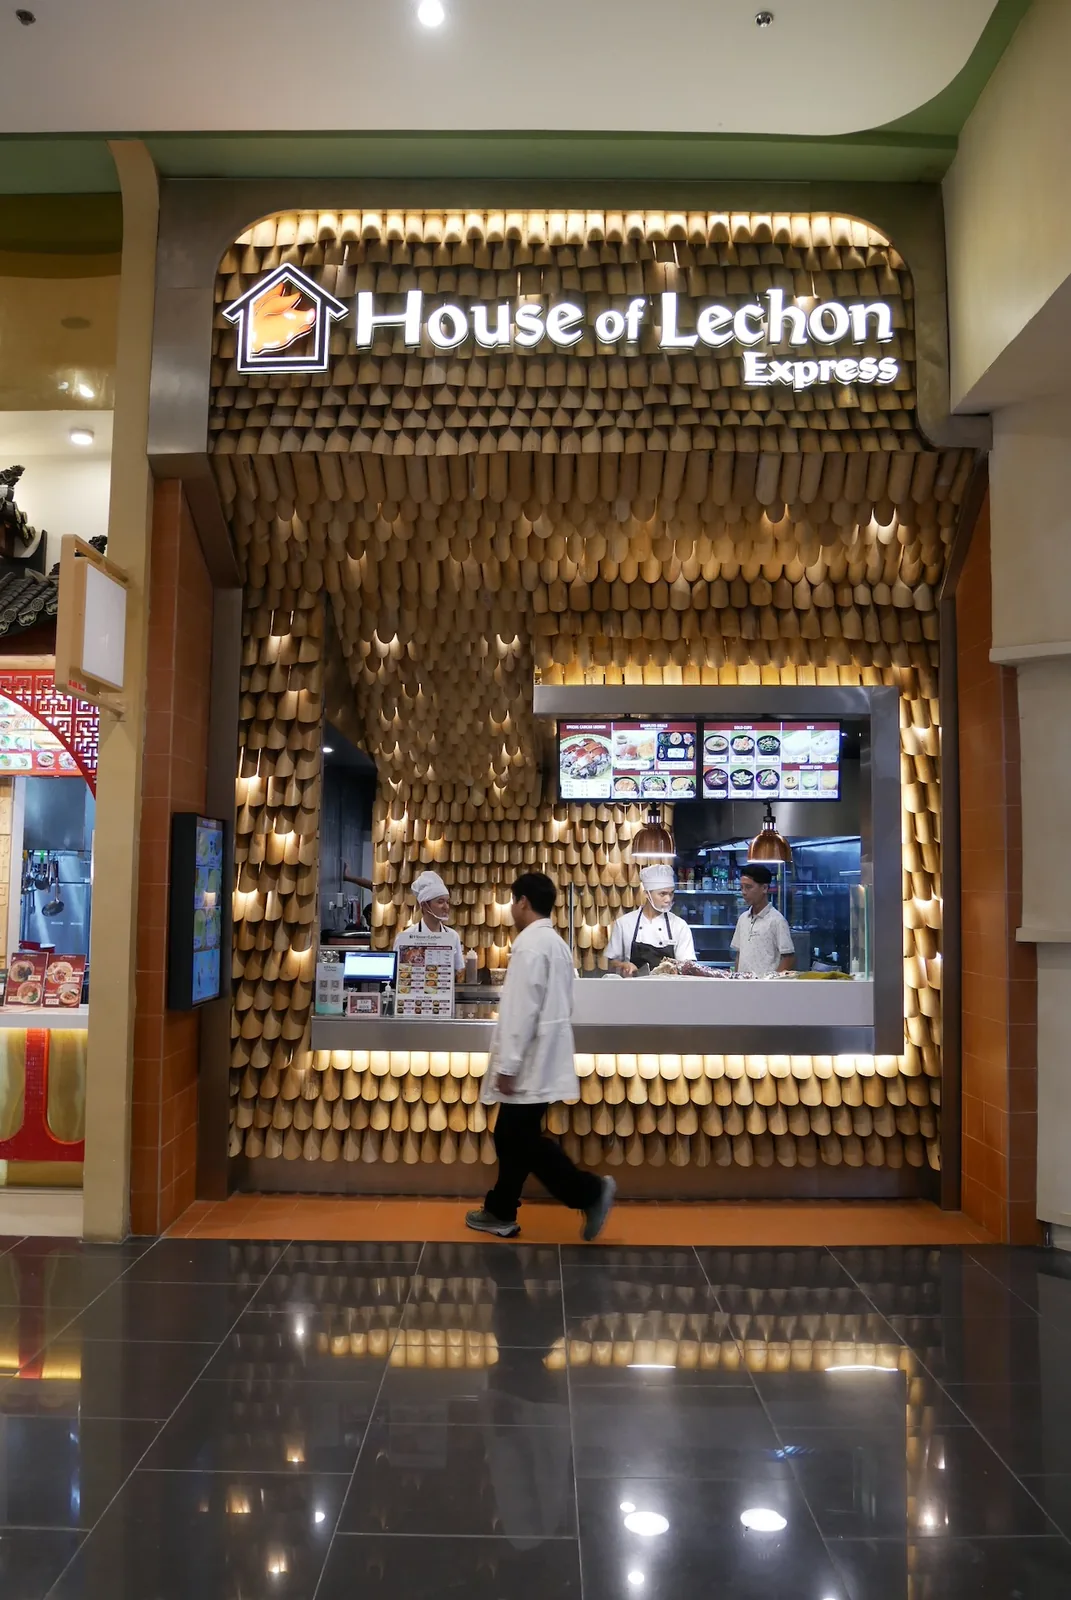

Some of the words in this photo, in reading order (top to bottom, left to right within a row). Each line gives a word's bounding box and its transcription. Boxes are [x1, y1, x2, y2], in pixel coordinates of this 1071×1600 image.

[355, 290, 584, 350] House
[595, 298, 645, 344] of
[658, 289, 894, 350] Lechon
[743, 351, 898, 392] Express
